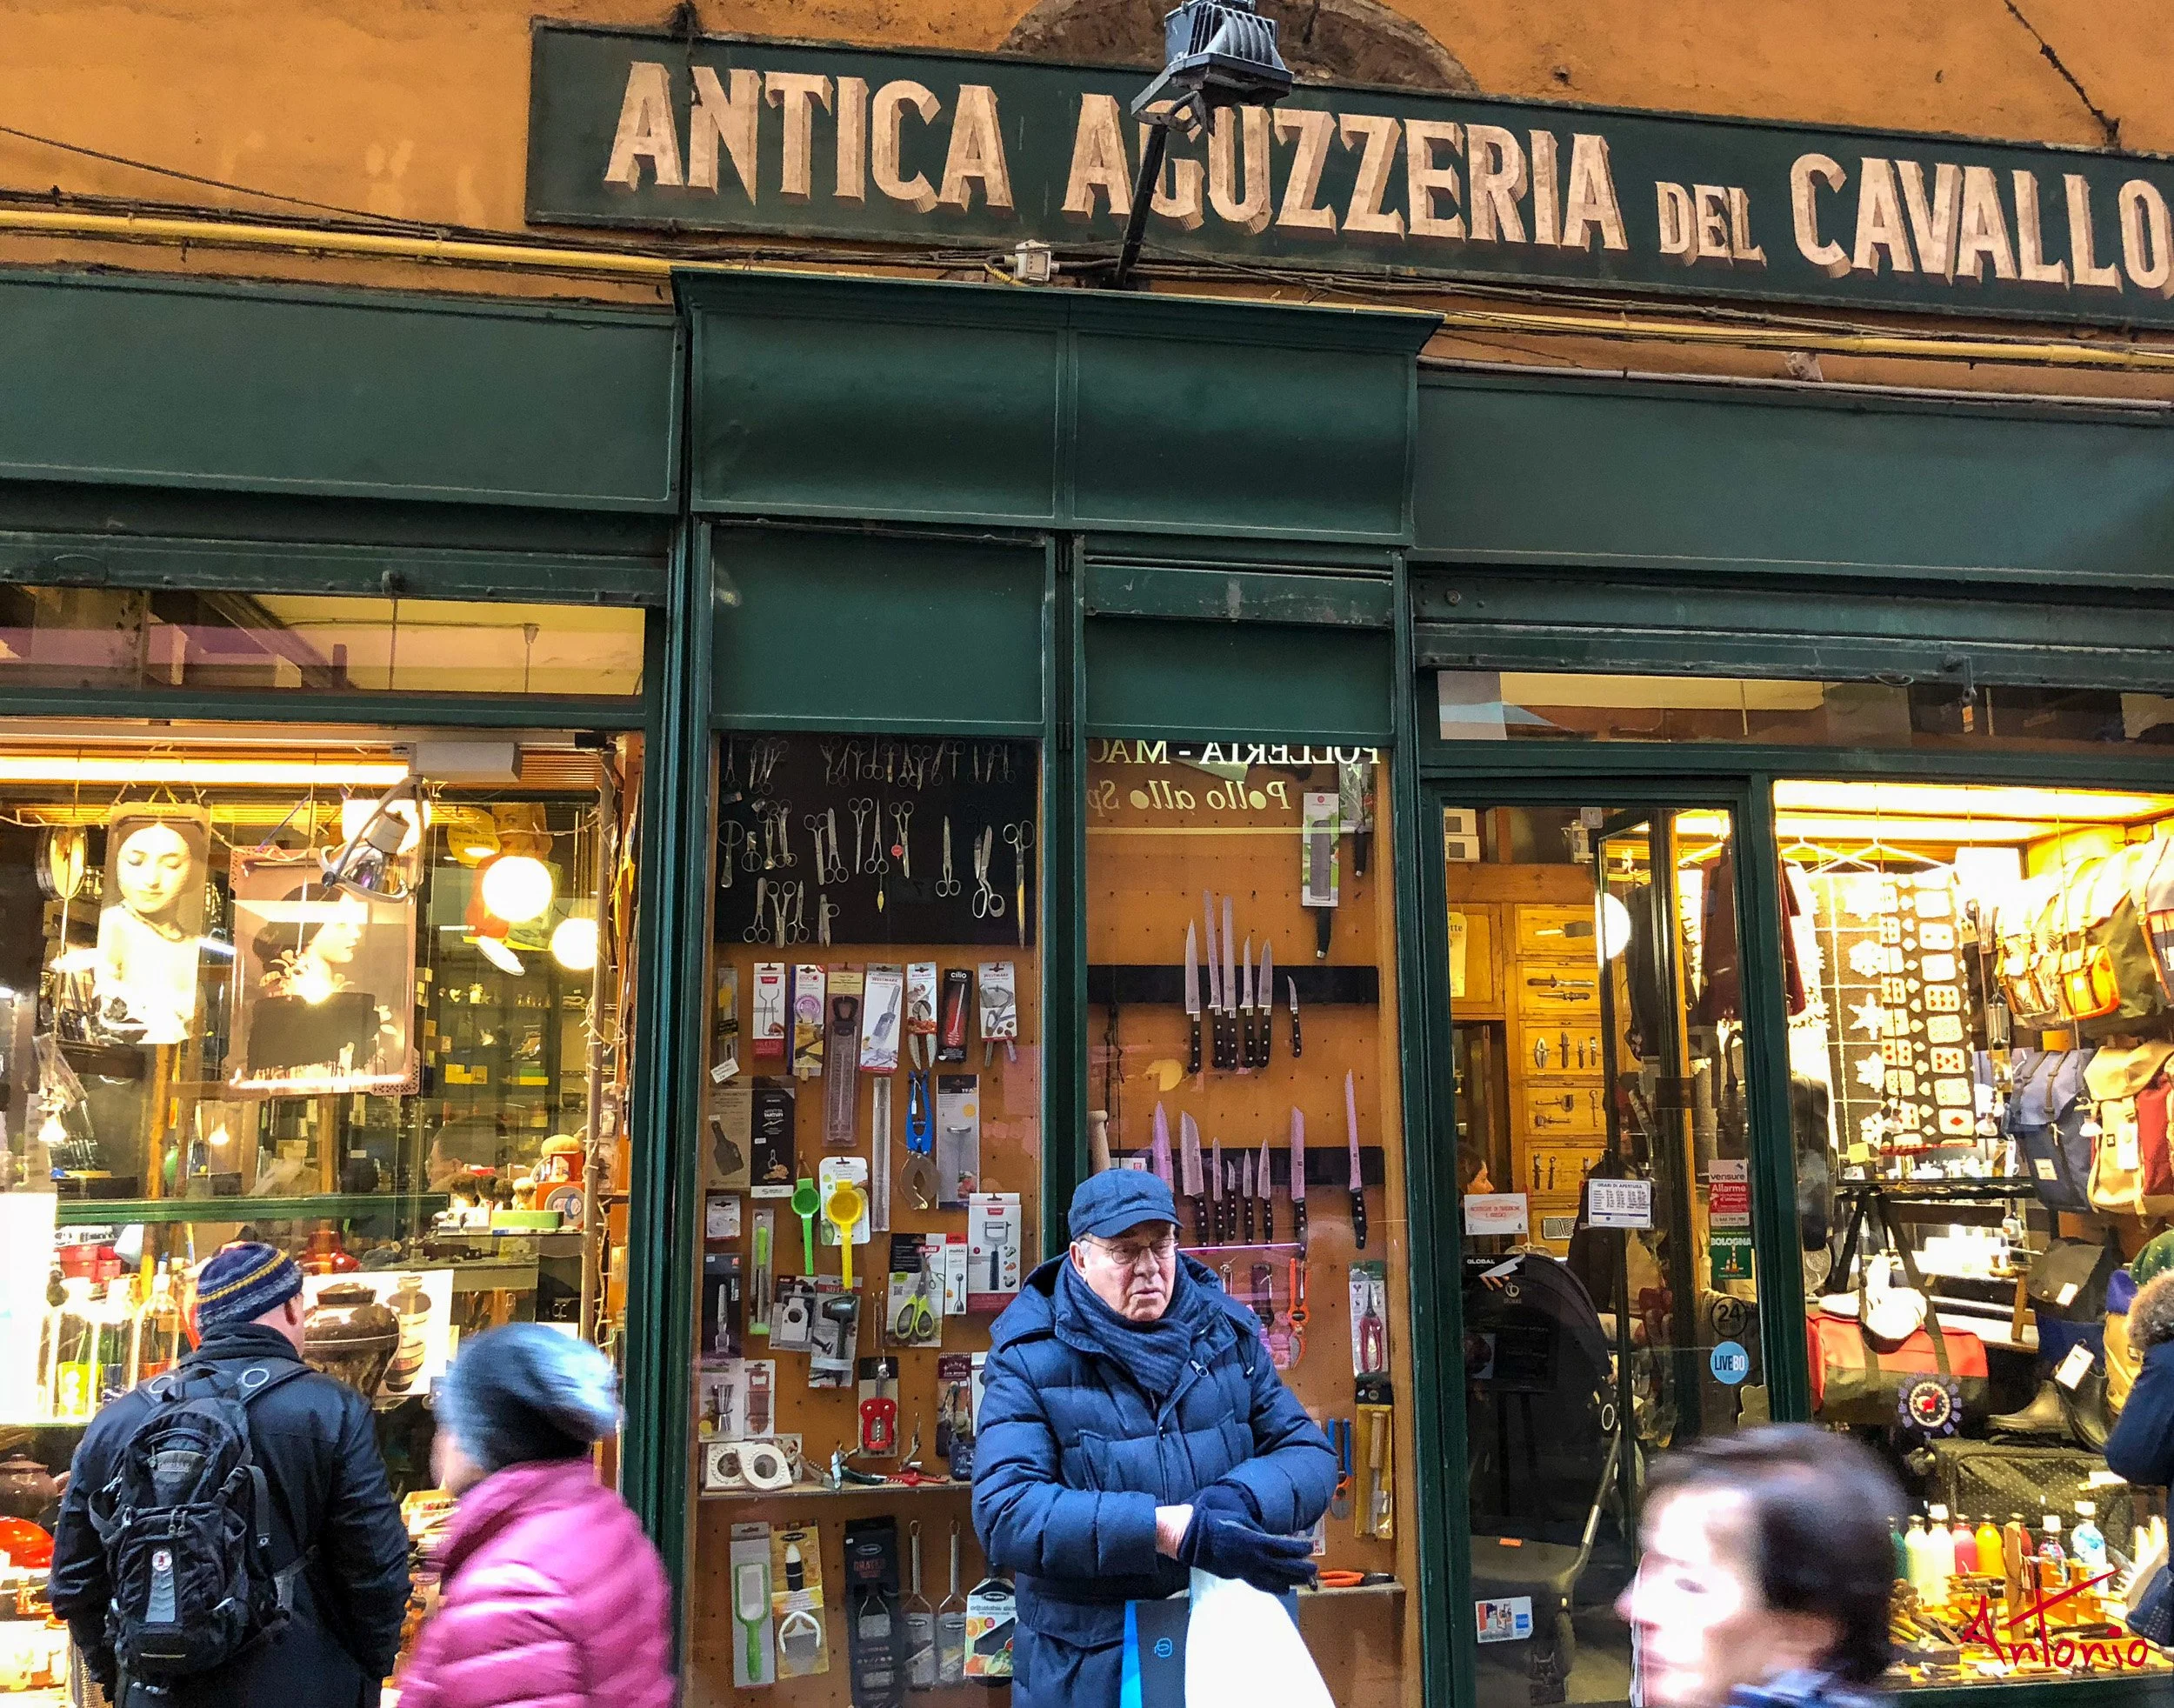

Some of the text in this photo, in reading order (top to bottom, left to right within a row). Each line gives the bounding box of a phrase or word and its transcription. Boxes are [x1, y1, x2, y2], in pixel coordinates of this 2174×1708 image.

[604, 61, 2174, 300] ANTICA AGUZZERIA DEL CAVALLO
[1711, 1183, 1746, 1192] Allarme
[1711, 1237, 1752, 1246] BOLOGNA
[1717, 1304, 1741, 1322] 24
